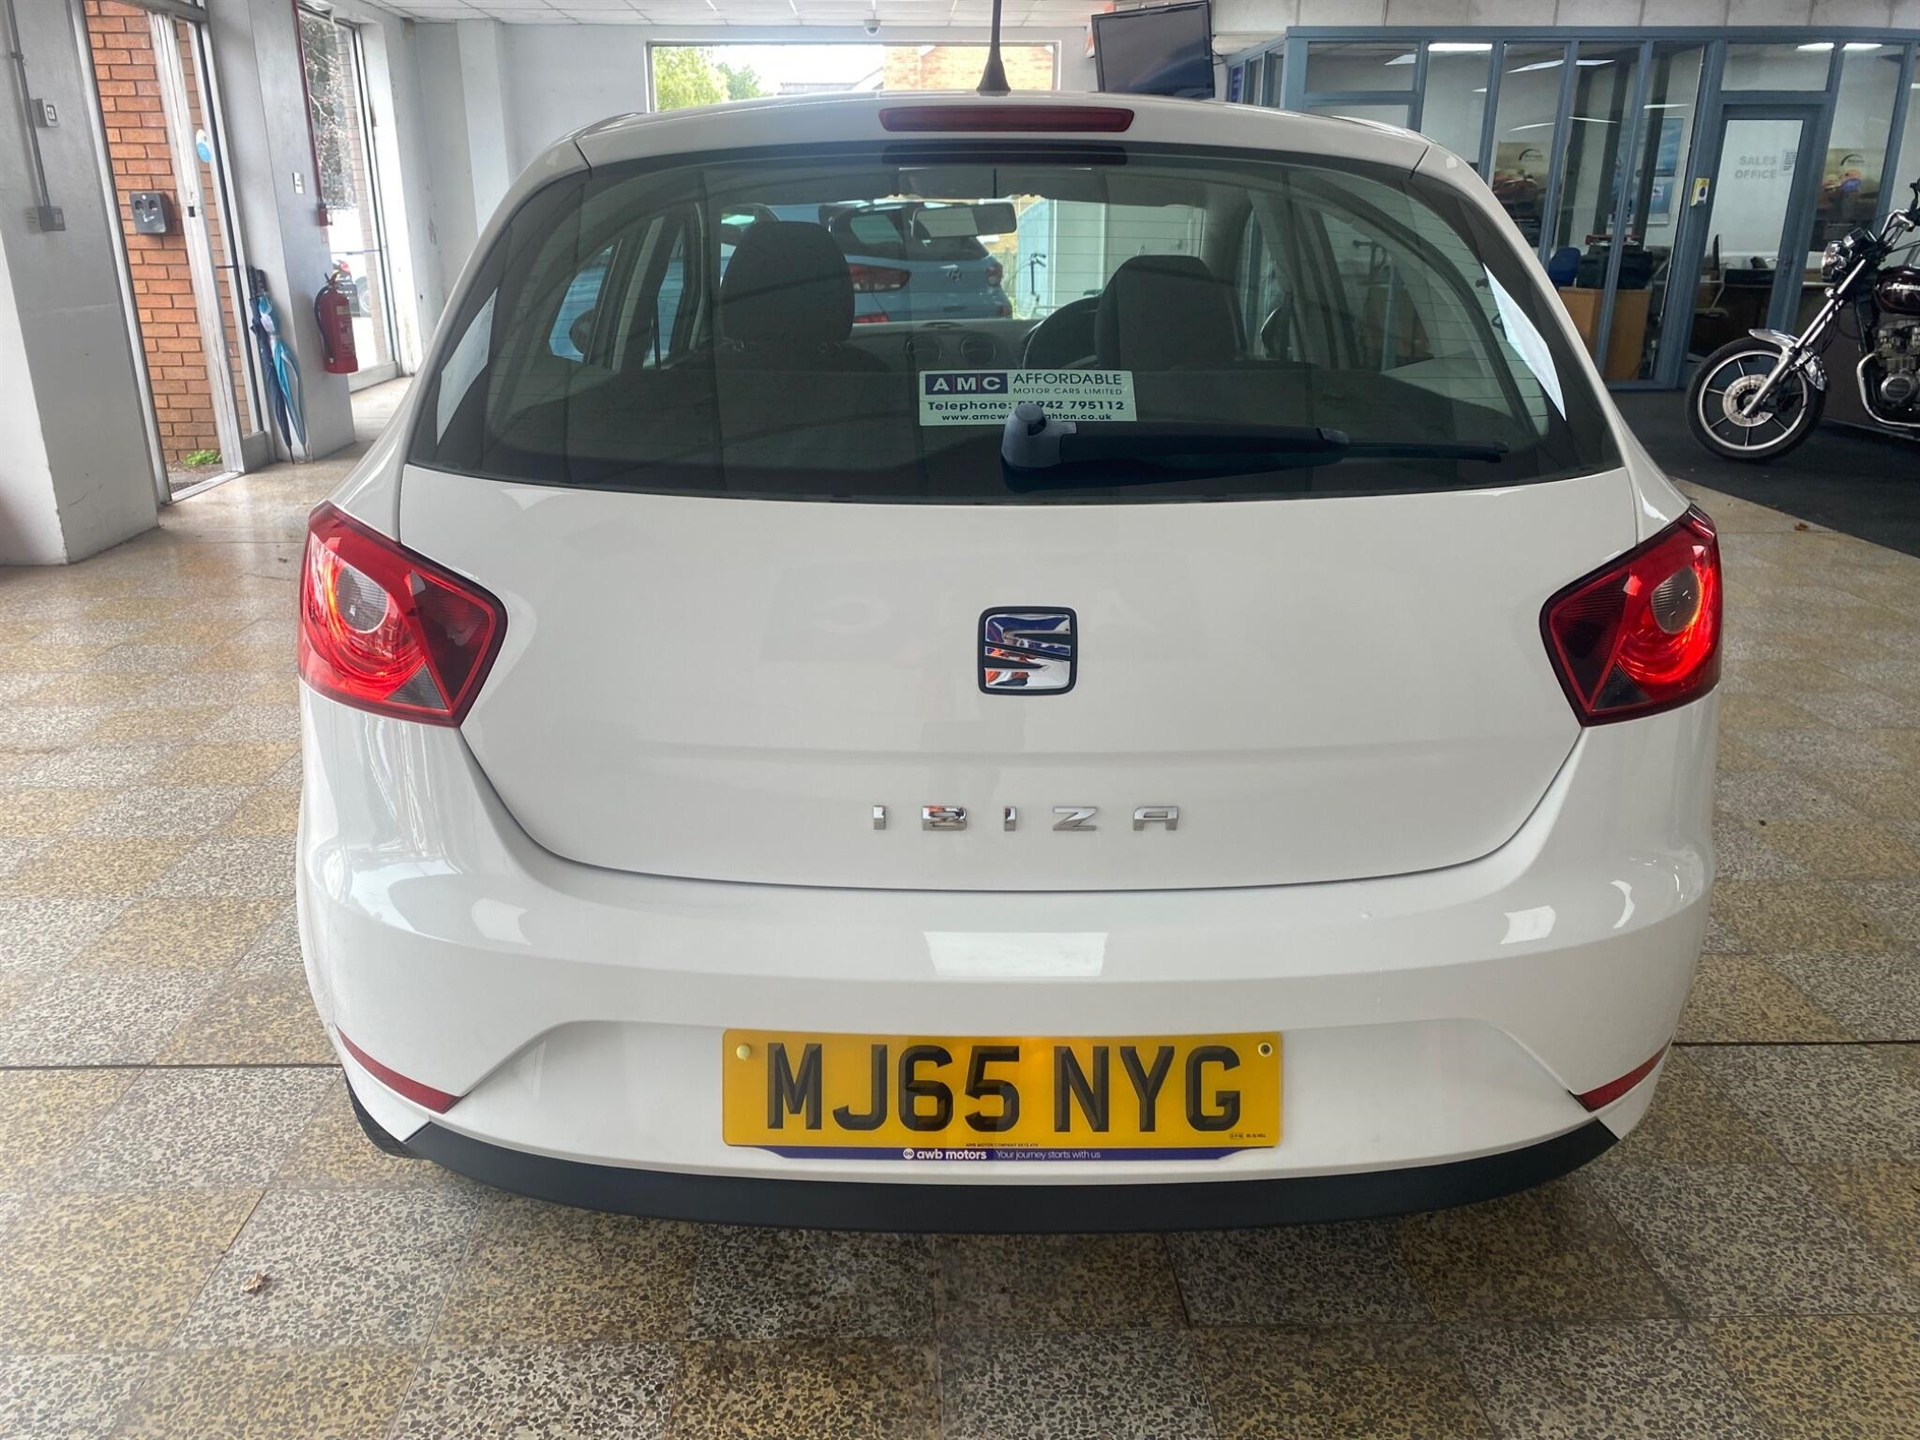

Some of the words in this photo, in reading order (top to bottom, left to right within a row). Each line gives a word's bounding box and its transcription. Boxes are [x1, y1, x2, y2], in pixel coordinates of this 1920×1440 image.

[1739, 155, 1777, 166] SALES
[1734, 169, 1777, 179] OFFICE
[932, 376, 1001, 391] AMC
[1012, 372, 1122, 385] AFFORDABLE
[1013, 387, 1052, 395] MOTOR
[927, 401, 1012, 412] Telephone:
[1017, 400, 1064, 410] 942
[1069, 400, 1125, 410] 795112
[872, 804, 1179, 832] IBIZA
[766, 1041, 1021, 1132] MJ65
[1053, 1044, 1242, 1133] NYG
[916, 1148, 943, 1160] awb
[945, 1149, 987, 1160] motors
[995, 1150, 1014, 1159] Your
[1015, 1150, 1046, 1161] journey
[1047, 1150, 1071, 1159] starts
[1072, 1150, 1090, 1159] with
[1091, 1151, 1101, 1159] us
